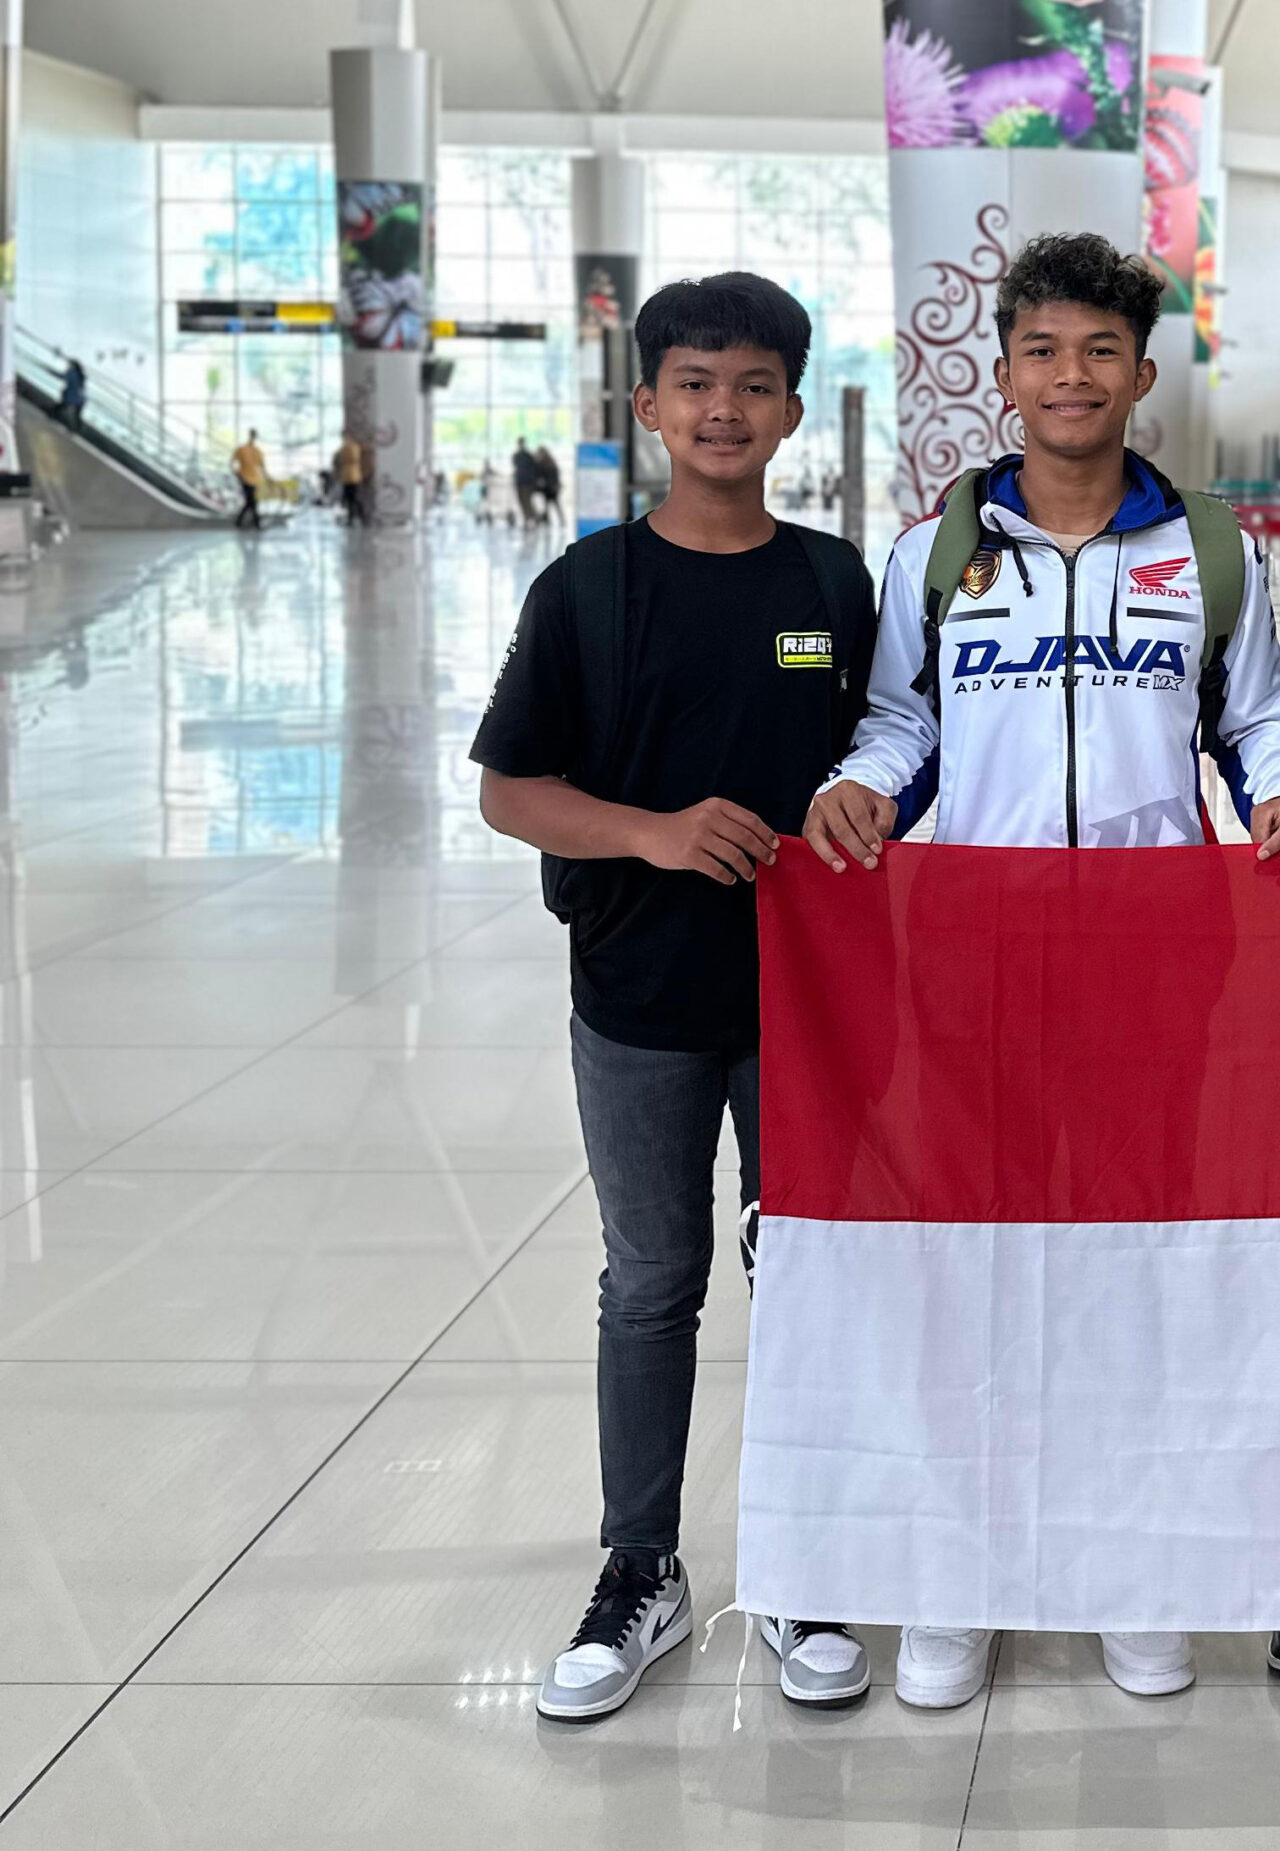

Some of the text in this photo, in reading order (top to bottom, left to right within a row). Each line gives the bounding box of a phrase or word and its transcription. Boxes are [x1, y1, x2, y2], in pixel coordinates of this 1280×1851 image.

[1129, 586, 1192, 600] HONDA
[952, 635, 1186, 679] DJAVA
[1153, 675, 1186, 691] MX
